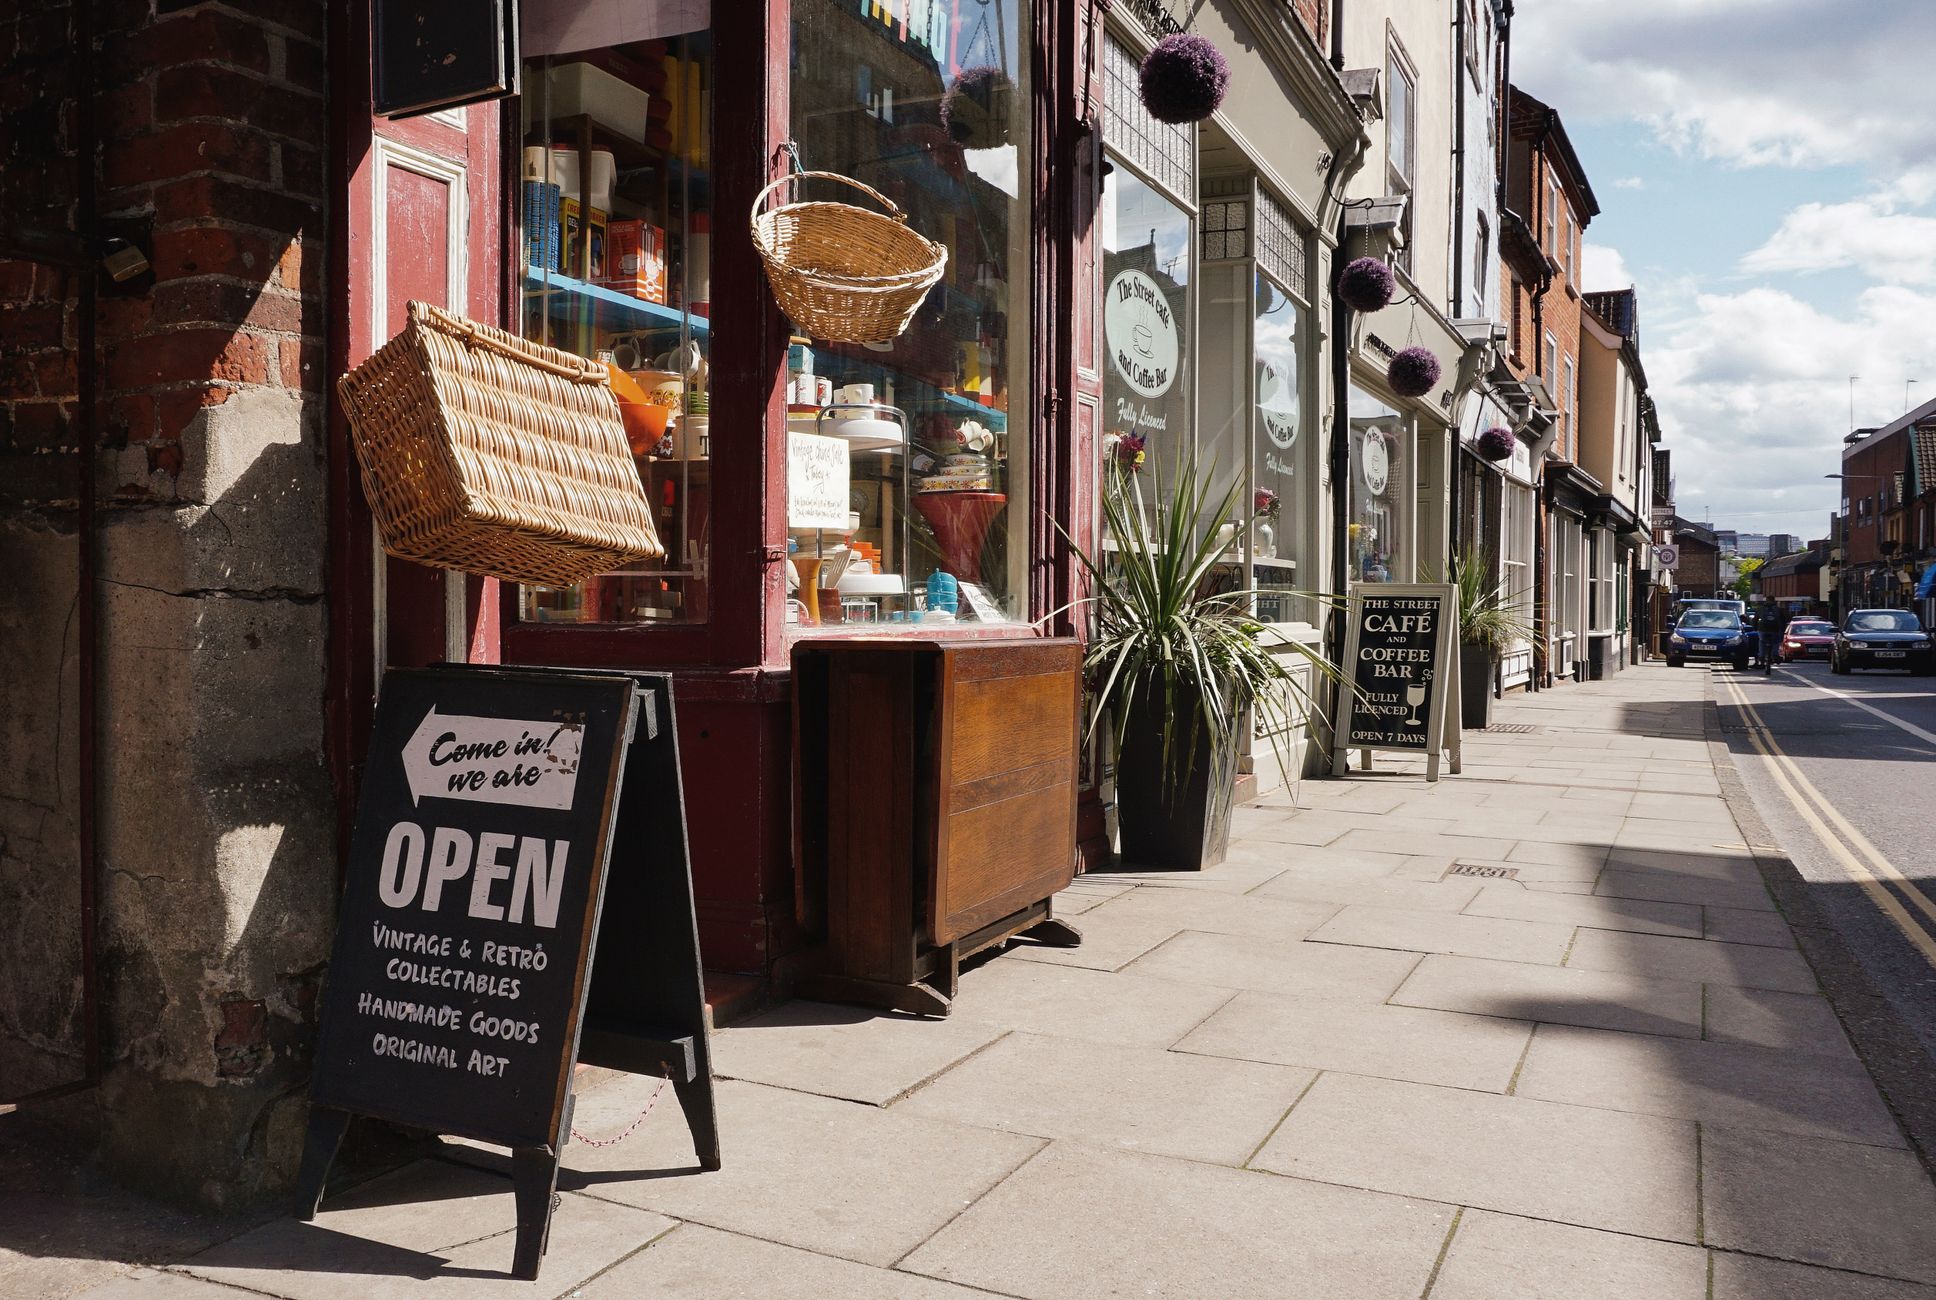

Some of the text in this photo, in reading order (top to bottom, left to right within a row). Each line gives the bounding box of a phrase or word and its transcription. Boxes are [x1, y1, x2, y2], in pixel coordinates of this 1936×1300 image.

[1117, 276, 1169, 329] The Street café
[1118, 349, 1167, 388] and Coffee Bar
[1117, 397, 1137, 428] Fully
[1364, 600, 1440, 610] THE STREET
[1364, 612, 1432, 633] CAFÉ
[1360, 647, 1430, 663] COFFEE
[1374, 664, 1413, 679] BAR
[1354, 705, 1408, 716] LICENCED
[1365, 692, 1399, 703] FULLY
[428, 731, 510, 767] Come
[1351, 731, 1426, 743] OPEN 7 DAYS
[447, 763, 543, 793] we are
[378, 821, 570, 929] OPEN
[373, 923, 548, 971] VINTAGE & RETRO
[386, 958, 521, 1000] COLLECTABLES
[358, 992, 540, 1044] HANDMADE GOODS
[372, 1033, 510, 1077] ORIGINAL ART
